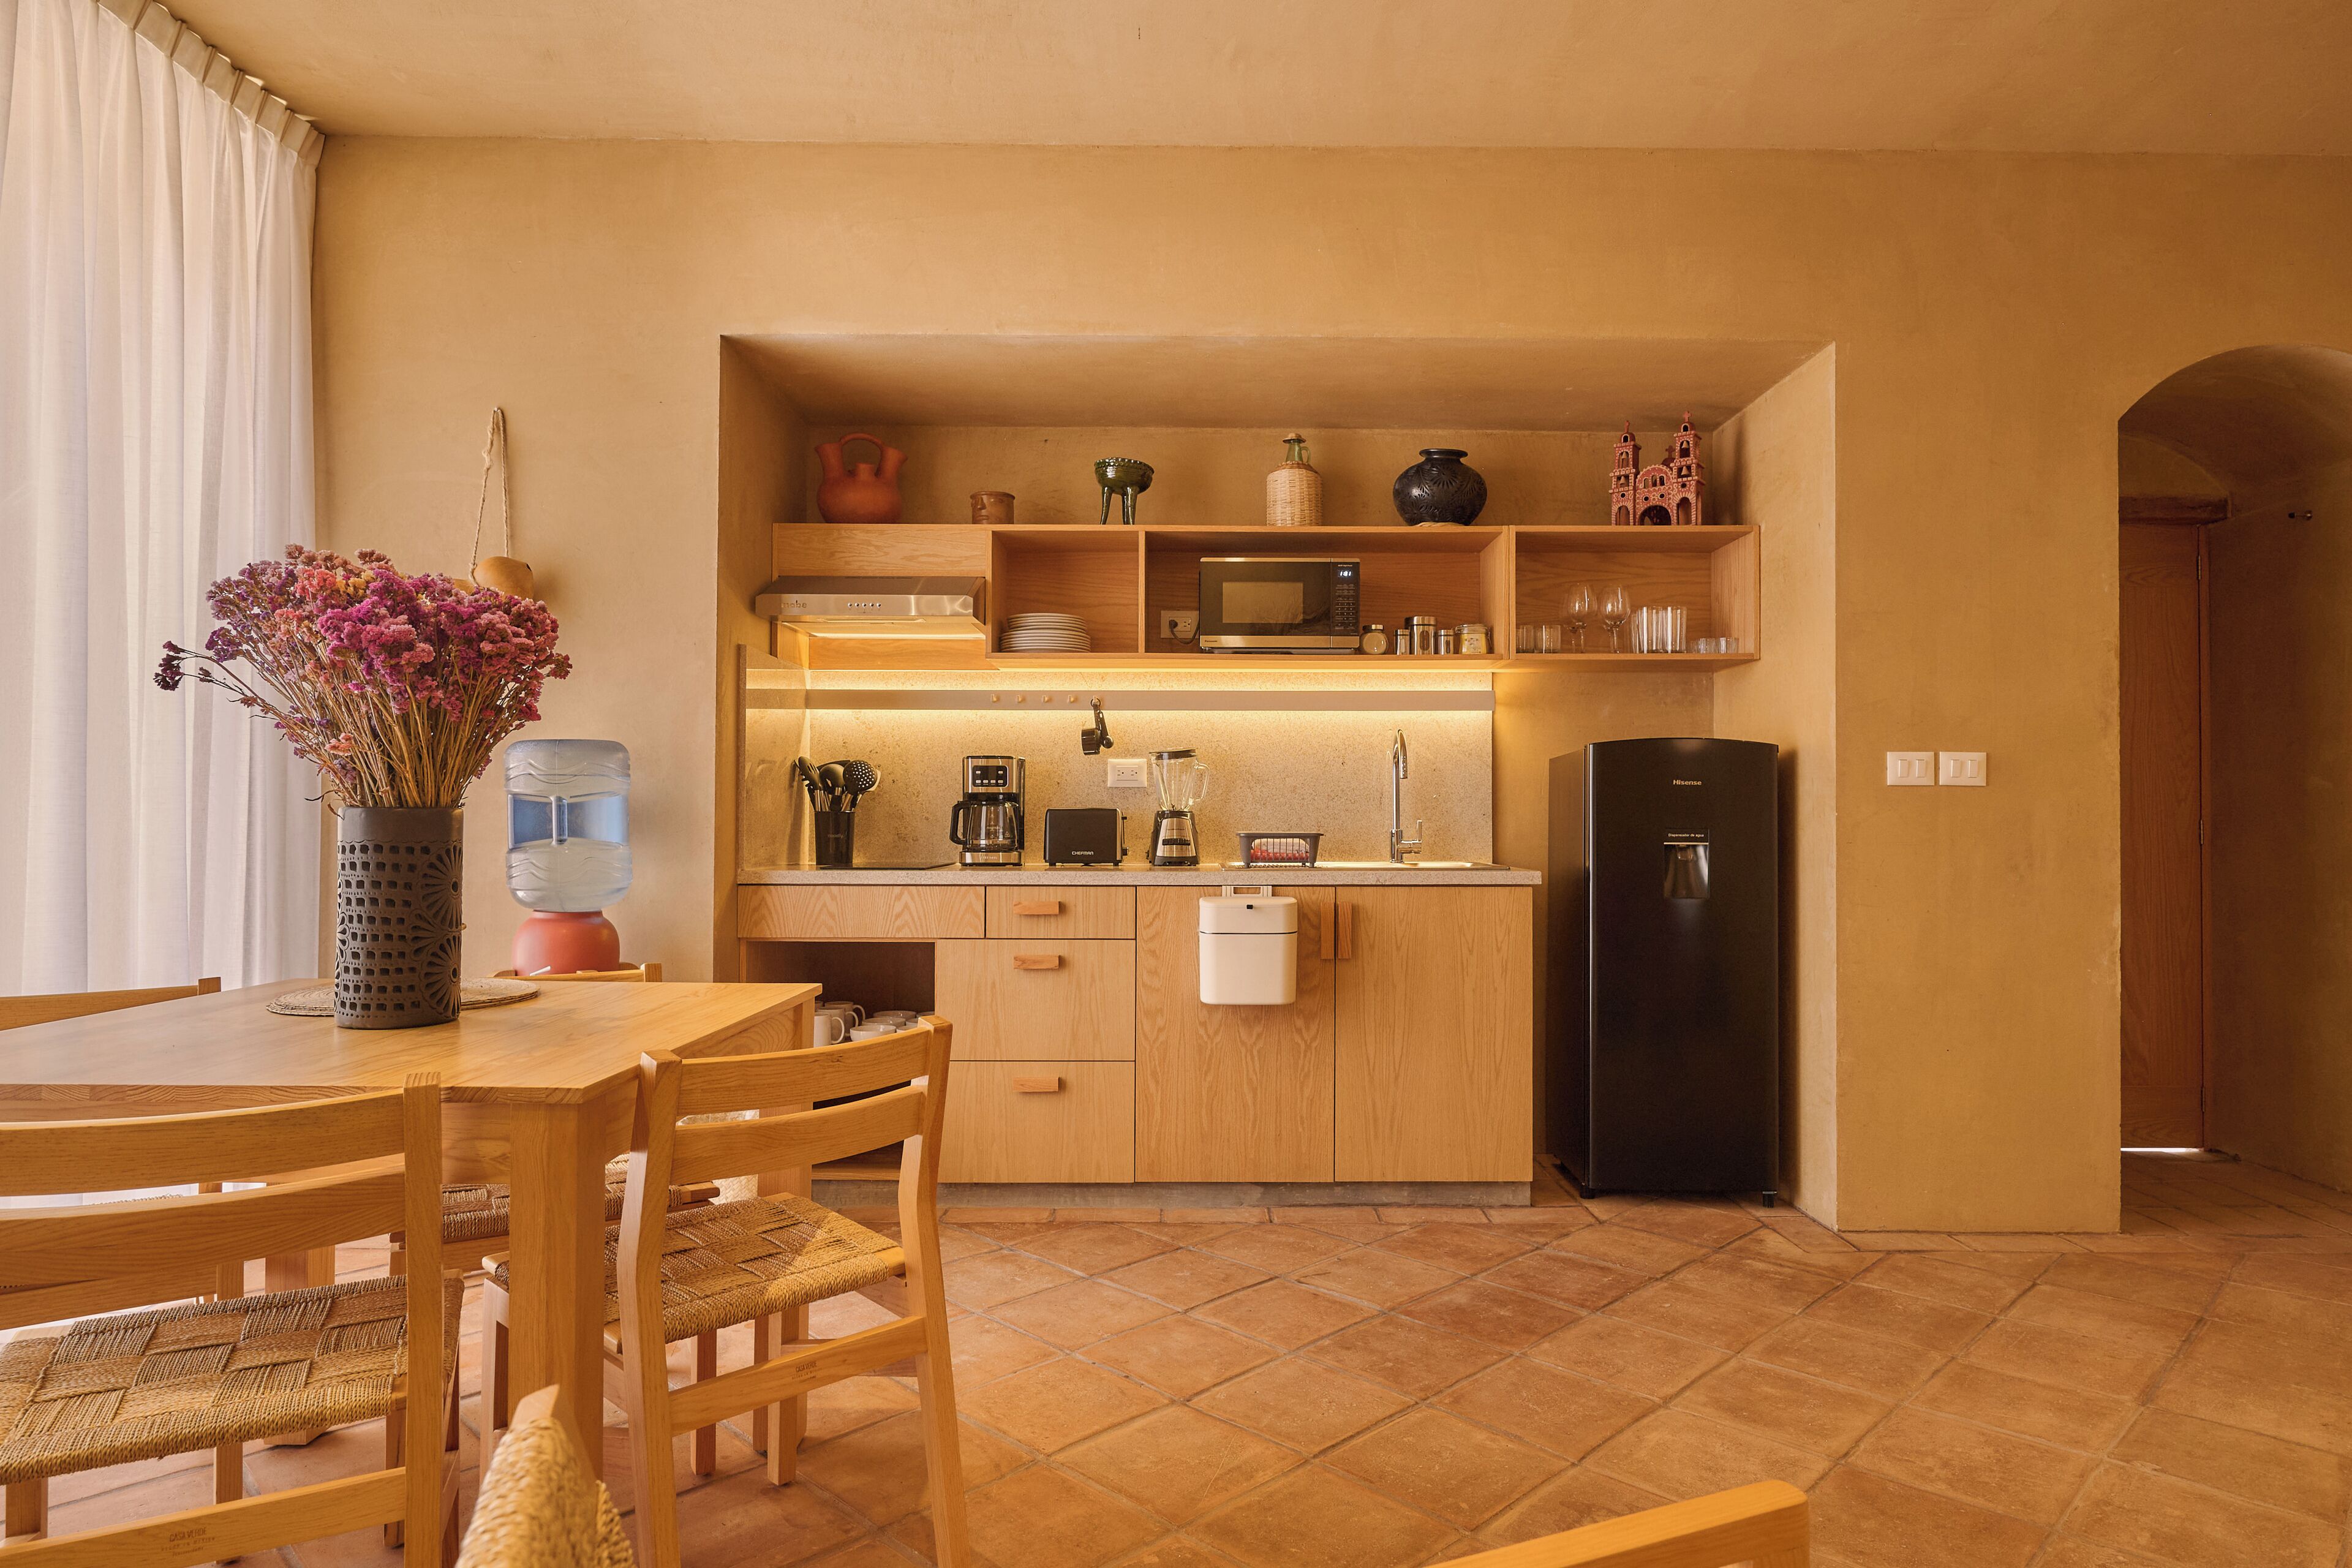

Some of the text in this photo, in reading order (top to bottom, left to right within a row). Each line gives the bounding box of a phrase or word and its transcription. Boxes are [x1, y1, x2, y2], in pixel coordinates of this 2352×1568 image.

[780, 600, 807, 608] mabe
[796, 1360, 818, 1373] CASA VERDE
[169, 1526, 206, 1543] CASA VERDE
